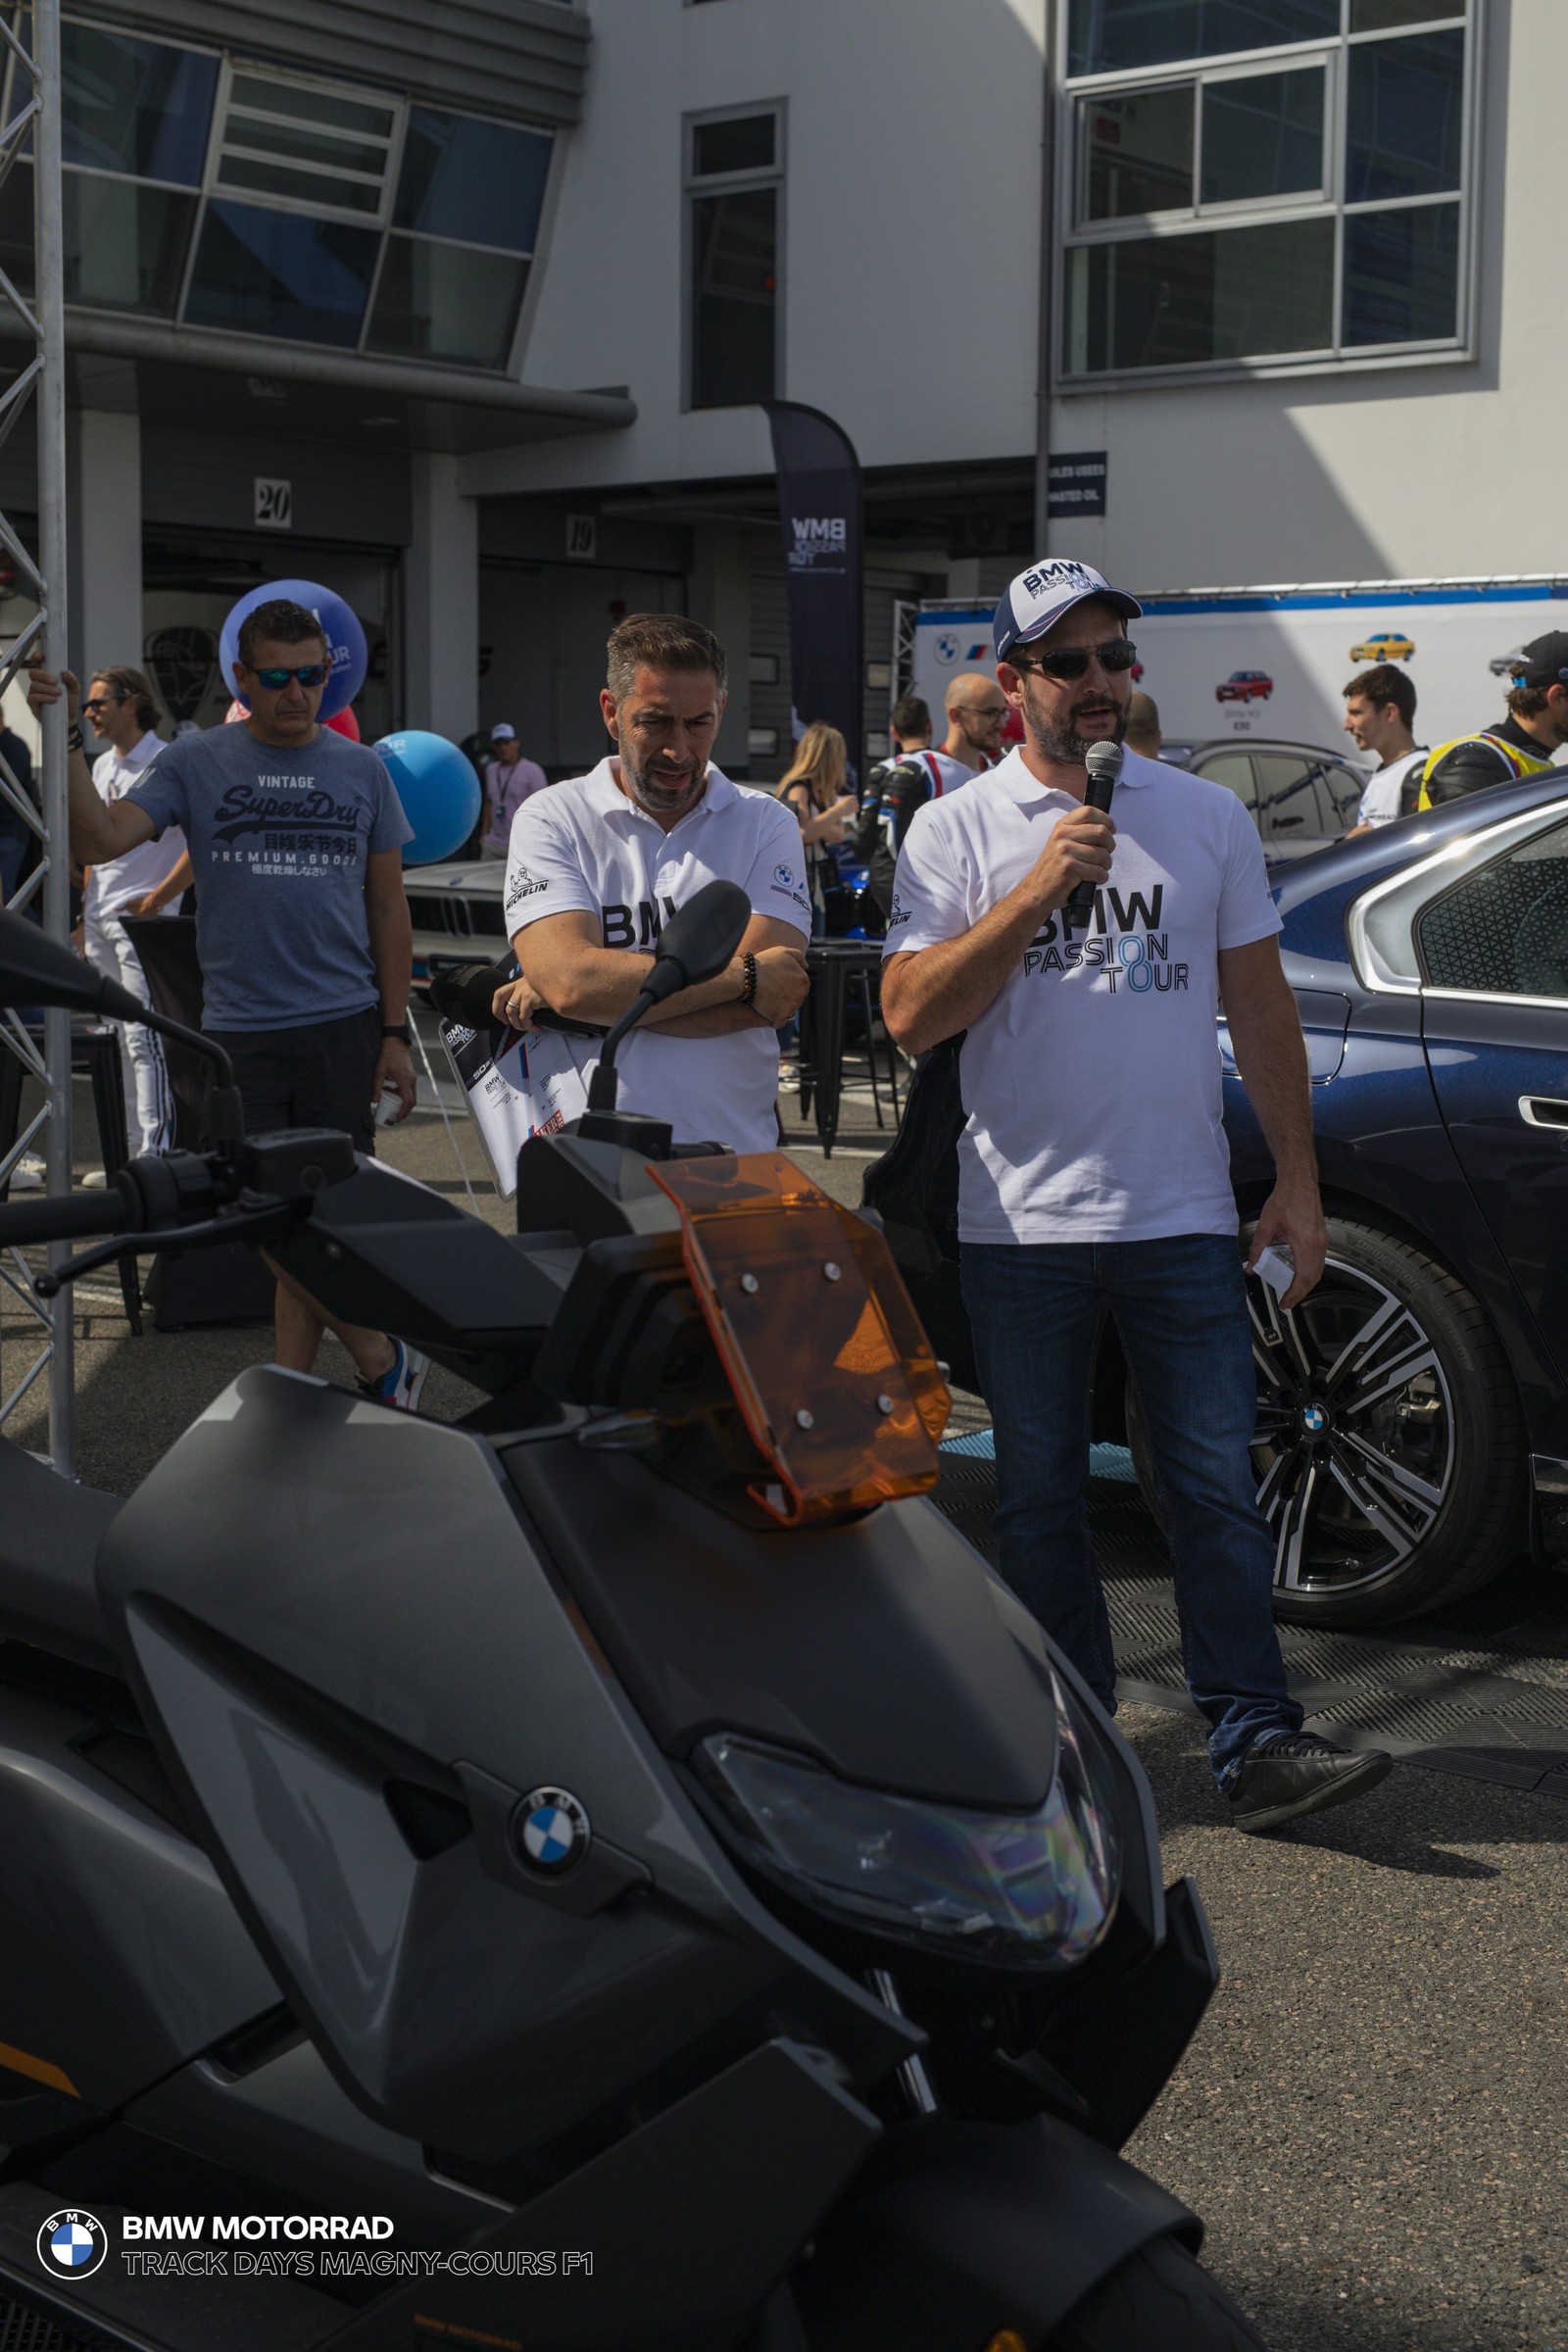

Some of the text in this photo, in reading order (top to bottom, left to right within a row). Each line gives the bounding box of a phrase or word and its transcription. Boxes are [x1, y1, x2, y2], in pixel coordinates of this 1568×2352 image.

[259, 485, 288, 521] 20
[570, 520, 591, 553] 19
[1022, 562, 1084, 592] BMW
[1030, 573, 1092, 600] PASSION
[258, 775, 316, 789] VINTAGE
[506, 882, 549, 910] MICHELIN
[602, 896, 676, 948] BM
[1024, 934, 1168, 977] PASSION
[1099, 963, 1189, 994] TOUR
[484, 1073, 501, 1092] BMW
[530, 1793, 586, 1835] BMW
